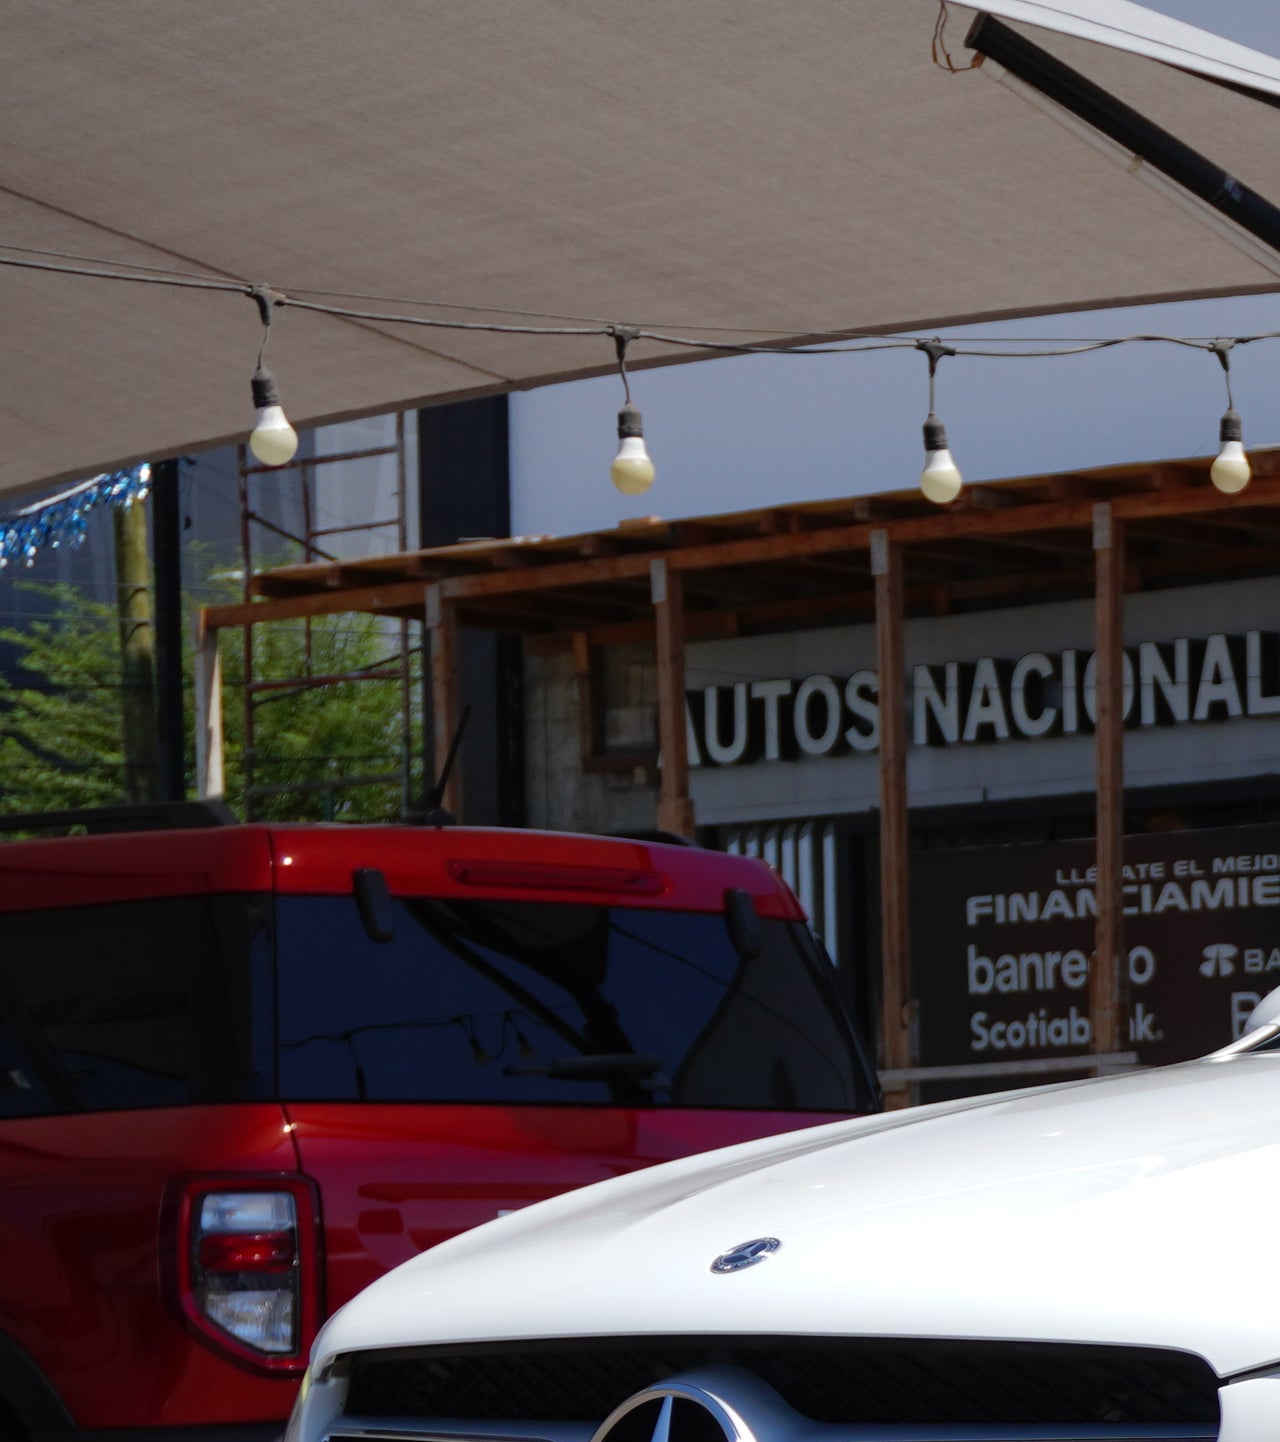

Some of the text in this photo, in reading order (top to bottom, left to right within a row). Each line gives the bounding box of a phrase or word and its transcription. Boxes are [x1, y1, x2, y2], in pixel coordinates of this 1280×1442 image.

[1054, 860, 1165, 884] LLÉATE
[1173, 858, 1205, 876] EL
[966, 943, 1156, 995] banreo
[968, 1002, 1160, 1052] Scotiabk
